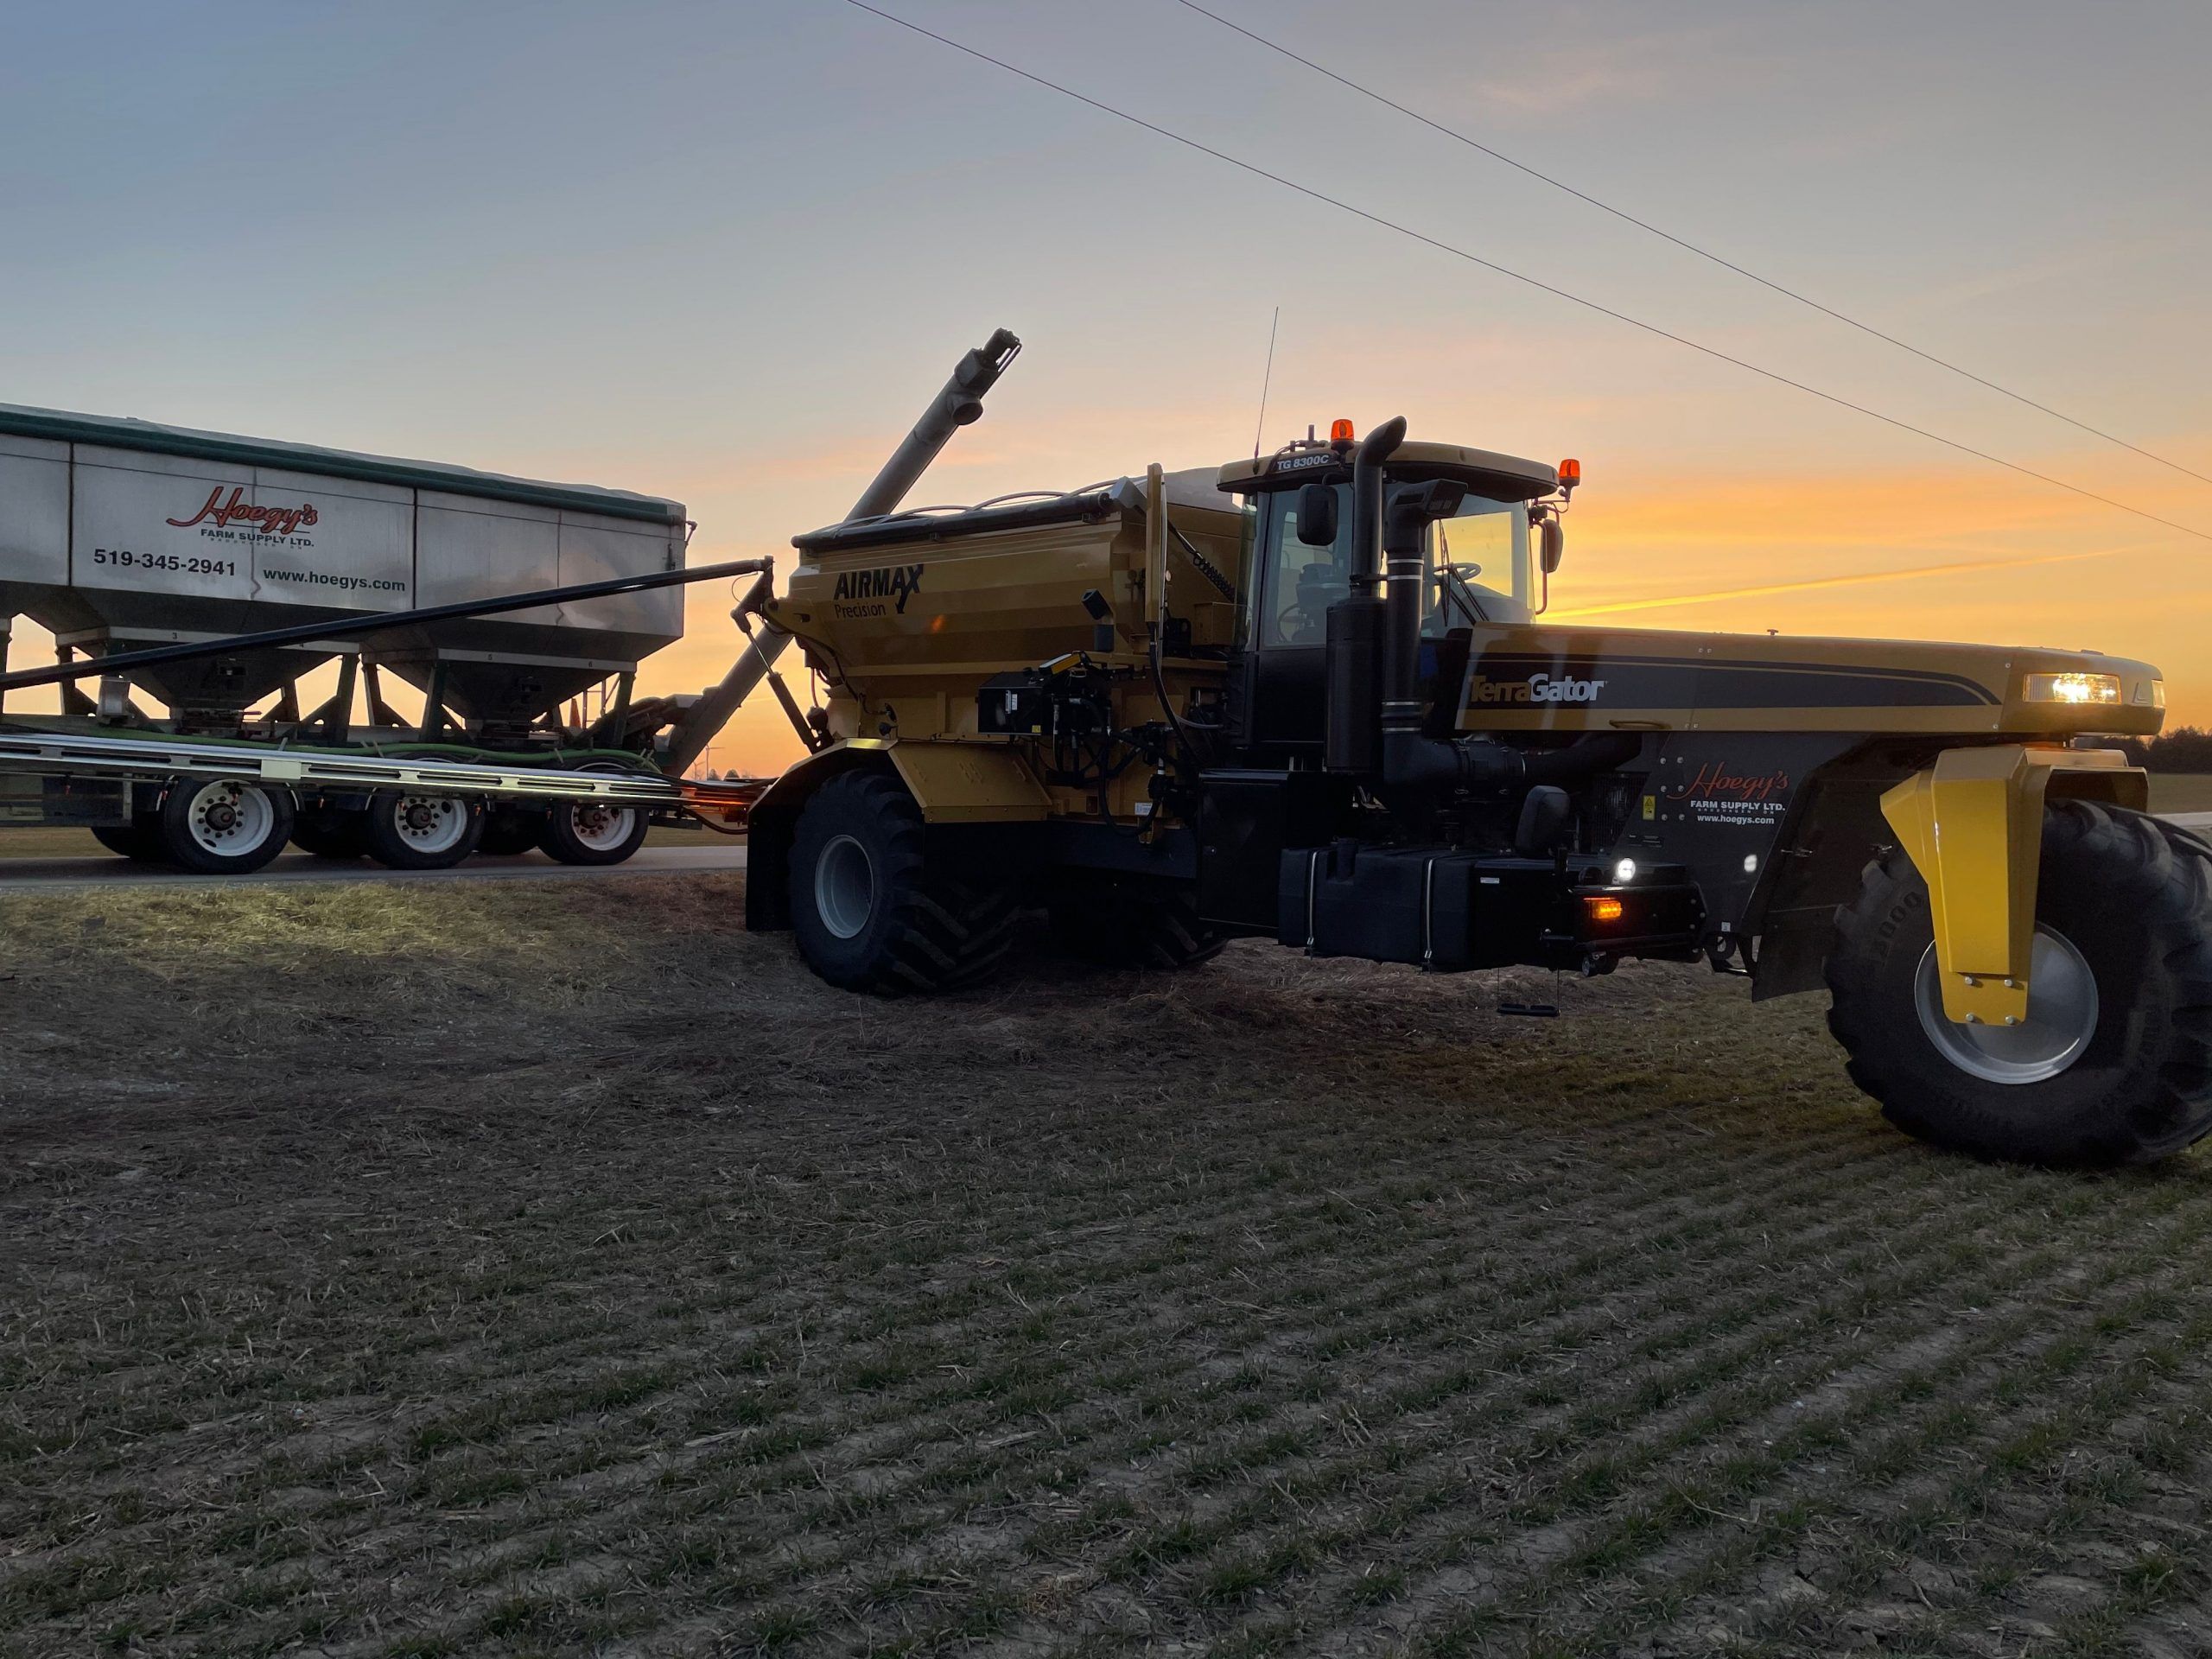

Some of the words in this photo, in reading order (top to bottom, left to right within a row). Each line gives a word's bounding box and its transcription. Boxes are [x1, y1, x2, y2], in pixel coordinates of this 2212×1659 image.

[1277, 460, 1292, 471] TG
[1294, 454, 1330, 468] 8300C
[166, 486, 318, 535] Hoegy's
[200, 528, 235, 539] FARM
[238, 532, 287, 544] SUPPLY
[289, 537, 315, 547] LTD.
[93, 548, 236, 576] 519-345-2941
[263, 569, 406, 592] www.hoegys.com
[833, 563, 925, 613] AIRMAX
[834, 602, 887, 620] Precision
[172, 632, 178, 640] 3
[1471, 672, 1605, 702] TerraGator
[1666, 761, 1789, 800] Hoegy's
[1690, 800, 1718, 809] FARM
[1720, 801, 1761, 810] SUPPLY
[1763, 803, 1786, 811] LTD.
[1696, 814, 1775, 825] www.hoegys.com
